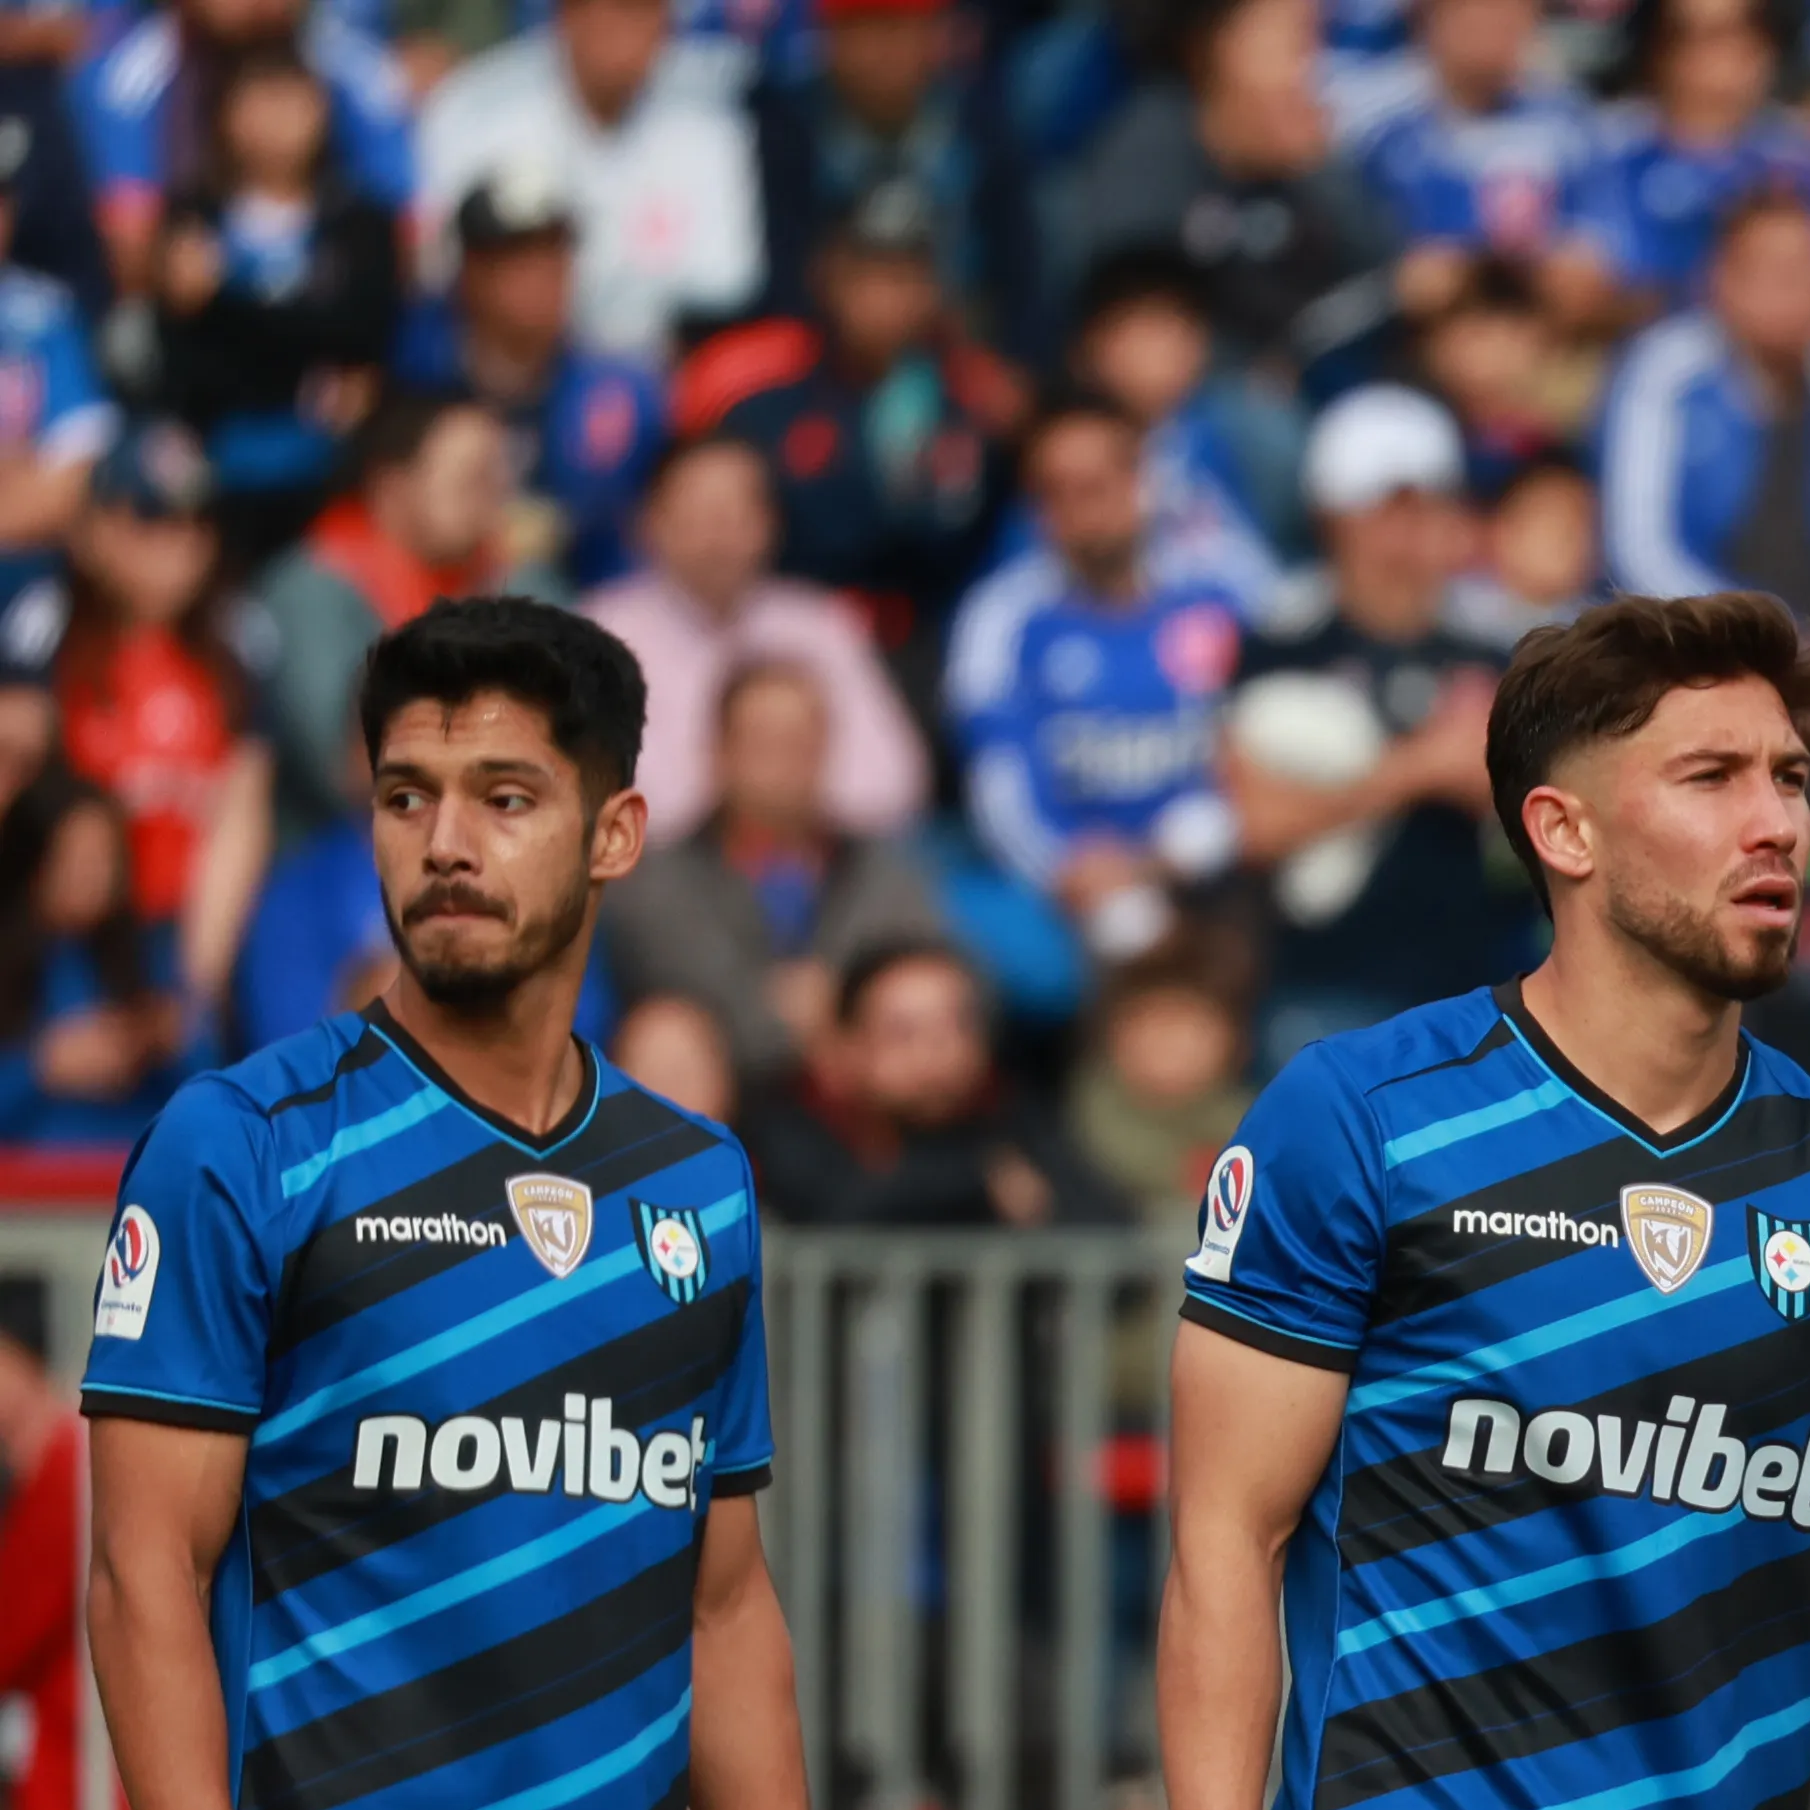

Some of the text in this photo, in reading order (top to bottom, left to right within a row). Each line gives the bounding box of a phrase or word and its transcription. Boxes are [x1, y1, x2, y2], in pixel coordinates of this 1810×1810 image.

[1640, 1195, 1695, 1216] CAMPEÓN
[356, 1212, 507, 1247] marathon
[1454, 1206, 1619, 1248] marathon
